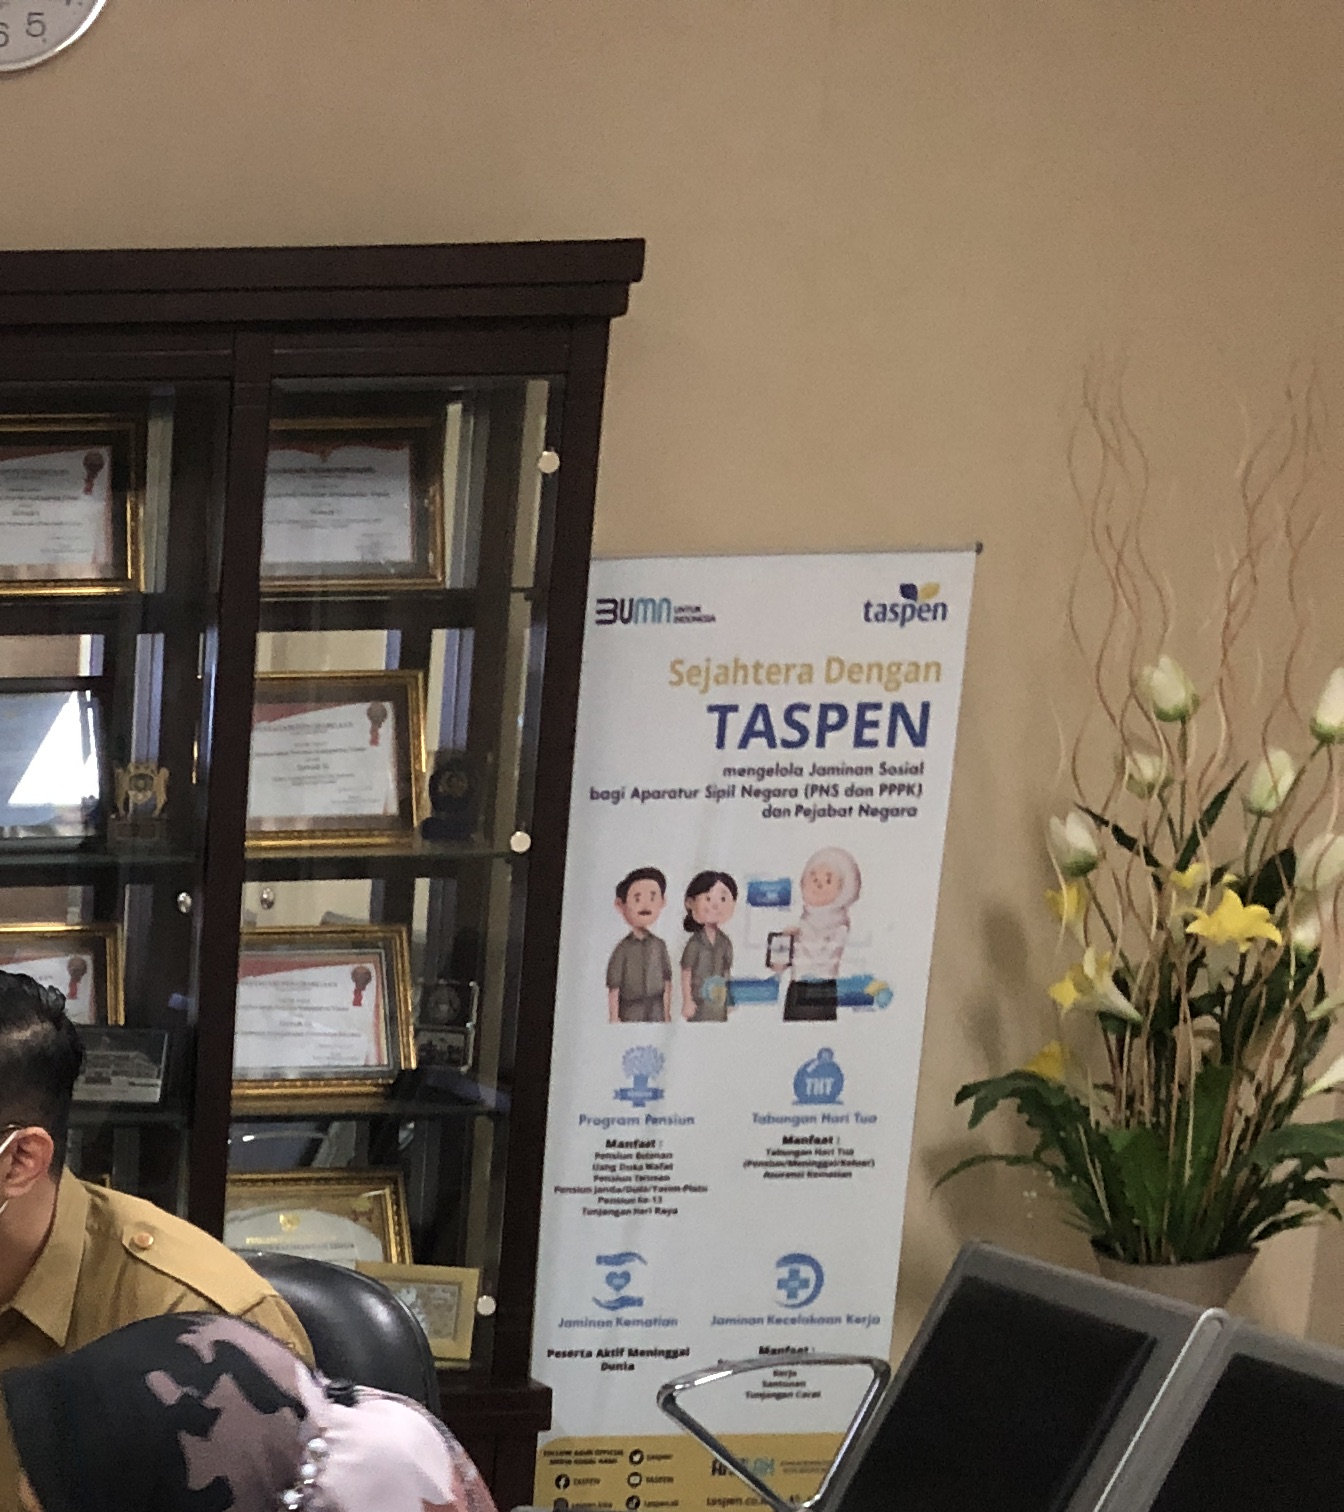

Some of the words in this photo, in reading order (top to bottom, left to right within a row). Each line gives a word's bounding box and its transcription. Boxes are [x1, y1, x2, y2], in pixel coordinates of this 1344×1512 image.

[26, 12, 46, 37] 5
[863, 599, 948, 627] taspen
[668, 656, 814, 694] Sejahtera
[824, 656, 942, 691] Dengan
[706, 700, 931, 750] TASPEN
[722, 762, 803, 782] mengelola
[808, 760, 874, 777] Jaminan
[879, 760, 925, 776] Sosial
[589, 785, 626, 805] bagi
[630, 785, 700, 804] Aparatur
[704, 784, 737, 803] Sipil
[741, 784, 799, 802] Negara
[804, 783, 840, 799] (PNS
[844, 782, 874, 798] dan
[879, 782, 924, 798] PPPK)
[762, 804, 791, 818] dan
[794, 803, 854, 823] Pejabat
[858, 803, 918, 822] Negara
[578, 1113, 640, 1130] Program
[645, 1113, 695, 1125] Pensiun
[753, 1112, 817, 1127] Tabungan
[822, 1112, 850, 1123] Hari
[854, 1111, 878, 1123] Tua
[605, 1139, 656, 1149] Manfaat
[782, 1134, 833, 1145] Manfaat
[558, 1317, 612, 1328] Jaminan
[615, 1316, 678, 1328] Kematian
[711, 1314, 764, 1326] Jaminan
[767, 1314, 842, 1326] Kecelakaan
[845, 1314, 881, 1328] Kerja
[547, 1348, 593, 1358] Peserta
[596, 1347, 625, 1358] Aktif
[627, 1347, 690, 1359] Meninggal
[600, 1362, 635, 1371] Dunia
